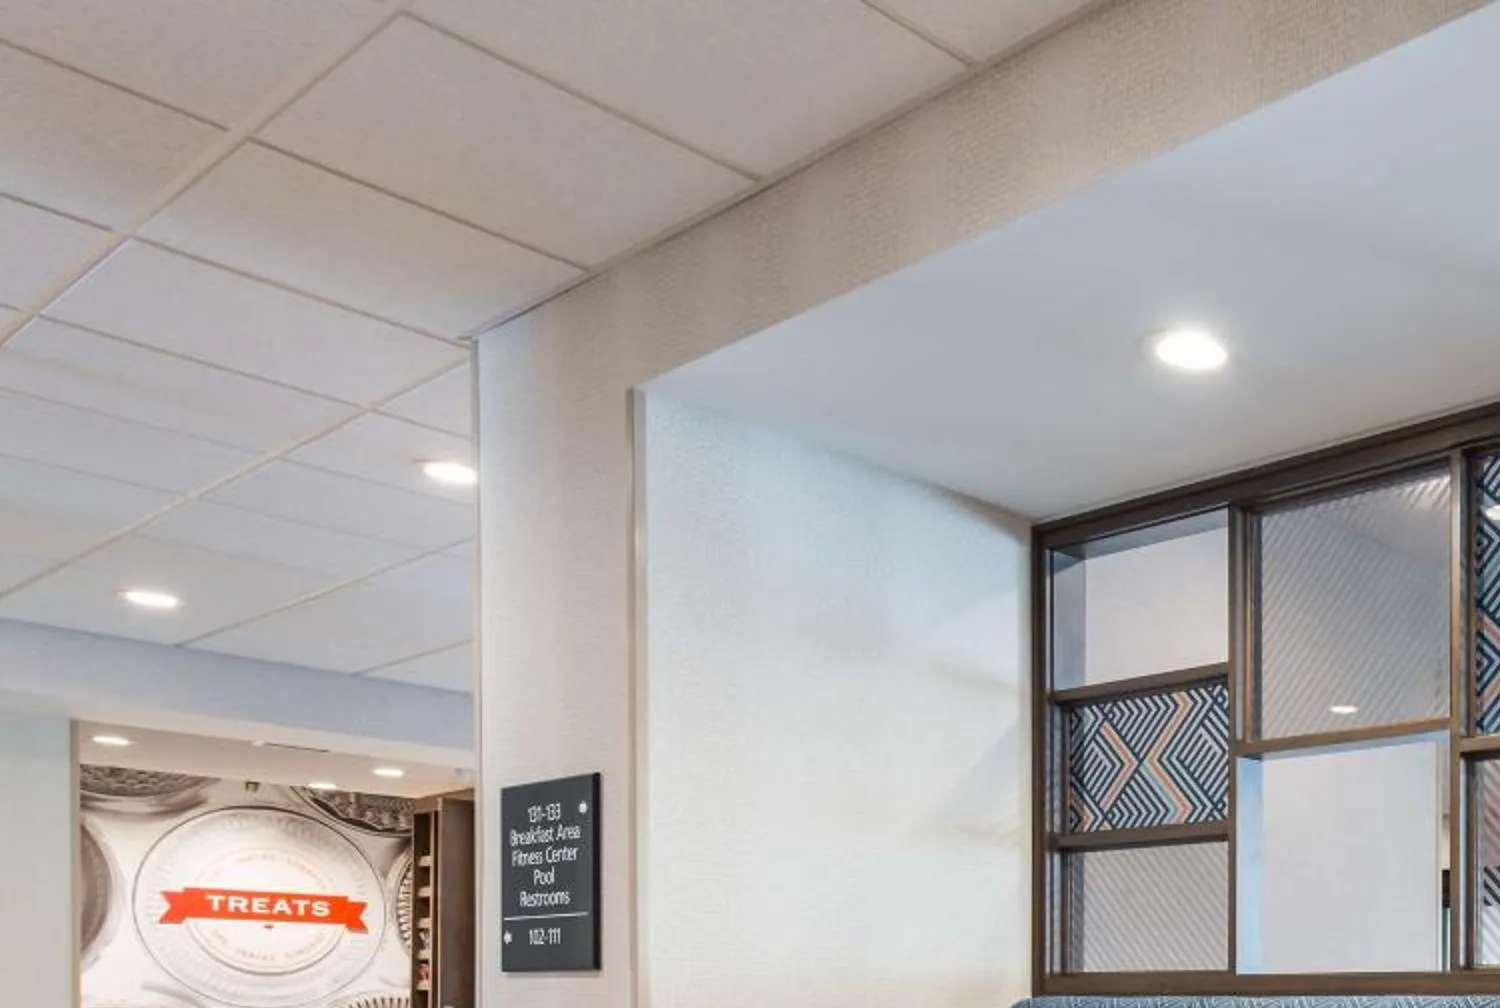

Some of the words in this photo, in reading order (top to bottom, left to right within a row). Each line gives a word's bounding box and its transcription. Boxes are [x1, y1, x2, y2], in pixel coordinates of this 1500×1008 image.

[510, 826, 554, 846] Breakfast
[556, 823, 580, 840] Area
[512, 849, 543, 867] Fitness
[545, 845, 578, 863] Center
[534, 865, 555, 885] Pool
[206, 894, 331, 917] TREATS
[520, 890, 570, 907] Restrooms
